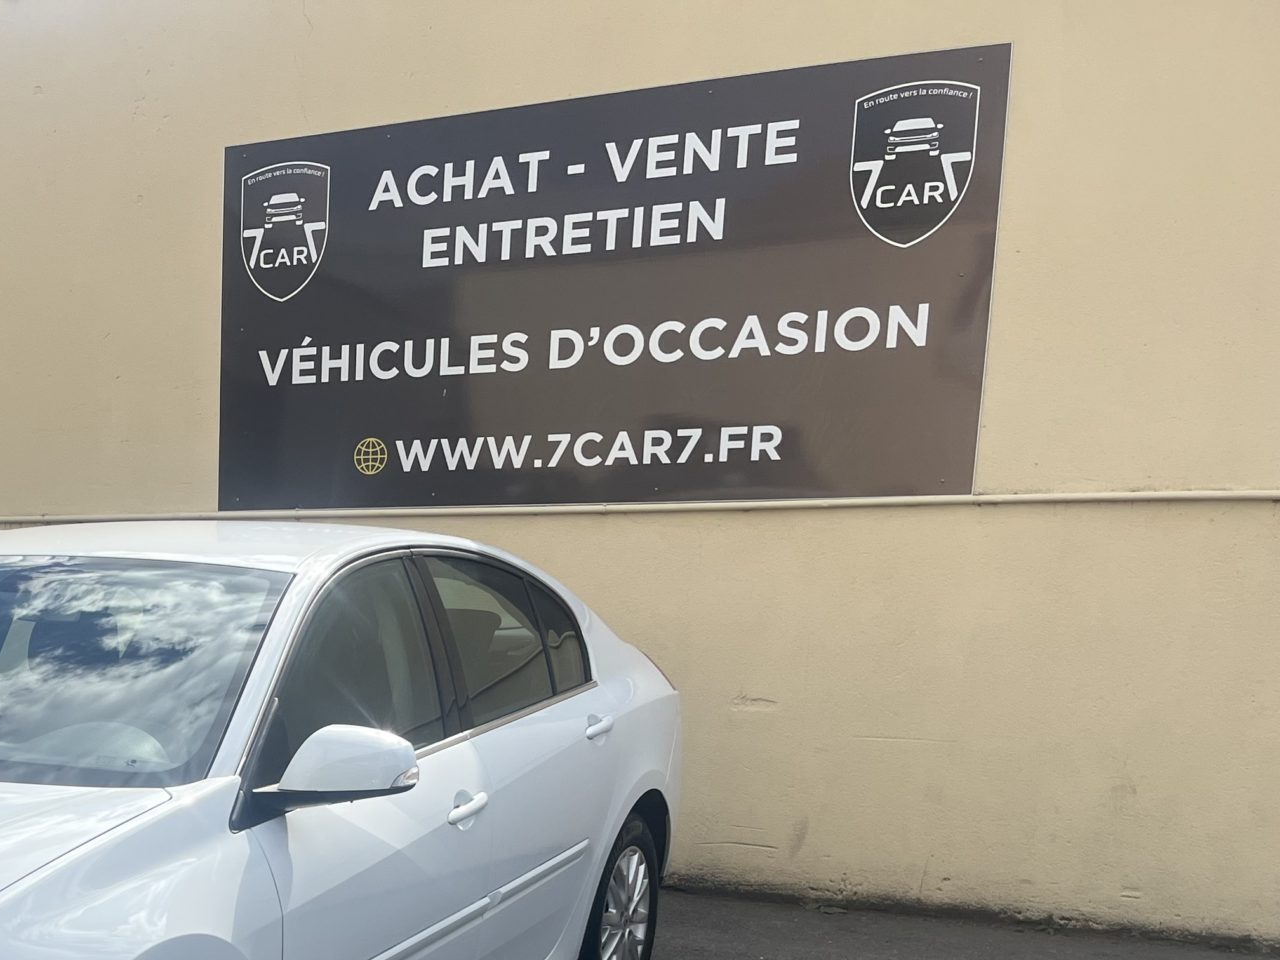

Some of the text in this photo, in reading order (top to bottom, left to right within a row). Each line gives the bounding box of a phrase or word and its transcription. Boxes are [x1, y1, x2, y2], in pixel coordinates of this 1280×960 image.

[875, 93, 898, 105] route
[900, 90, 918, 98] vers
[919, 88, 927, 96] la
[928, 88, 968, 98] confiance
[368, 119, 800, 211] ACHAT - VENTE
[422, 197, 726, 268] ENTRETIEN
[258, 332, 529, 386] VÉHICULES
[395, 425, 783, 472] WWW.7CAR7.FR
